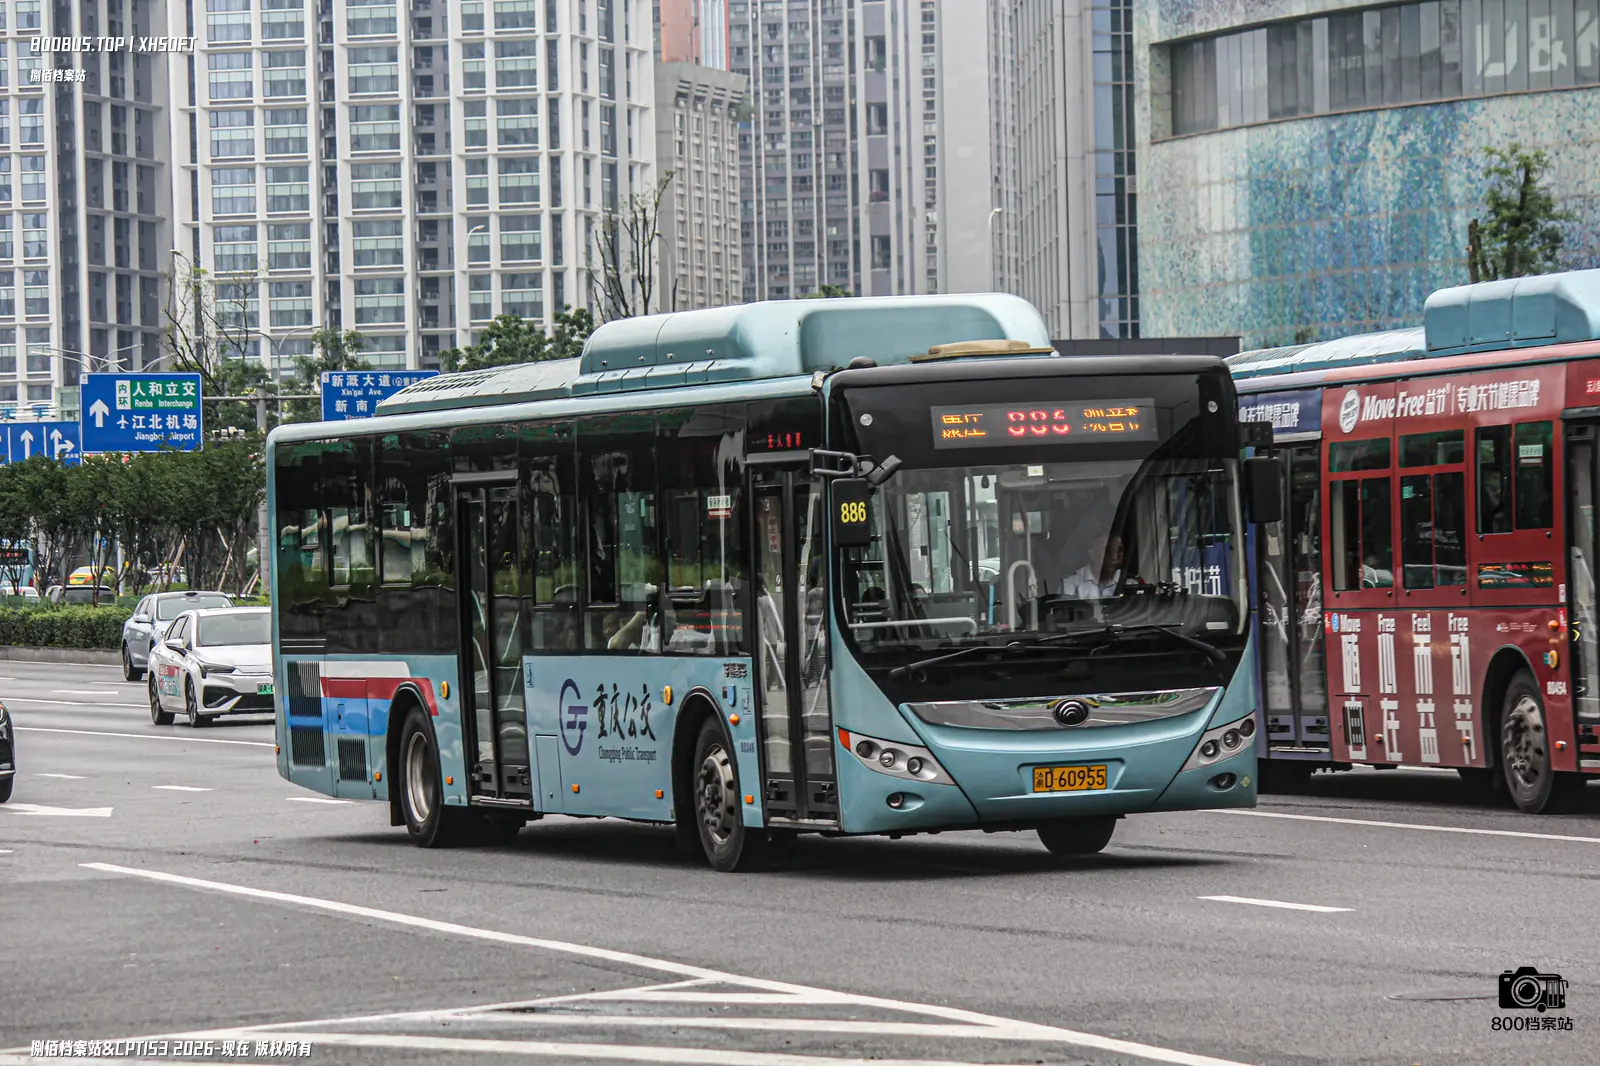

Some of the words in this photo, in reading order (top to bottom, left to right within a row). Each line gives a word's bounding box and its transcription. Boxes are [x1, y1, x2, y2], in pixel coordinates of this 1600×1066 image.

[132, 381, 196, 397] 人和立交
[331, 374, 390, 387] 新溉大道
[134, 399, 153, 408] Renhe
[158, 399, 193, 409] Interchange
[1361, 394, 1396, 422] Move
[1396, 391, 1425, 418] Free
[132, 414, 197, 430] 江北机场
[841, 501, 867, 523] 886
[1340, 614, 1361, 632] Move
[1378, 613, 1395, 632] Free
[1412, 613, 1431, 632] Feel
[1448, 612, 1469, 632] Free
[593, 683, 656, 741] 重庆公交
